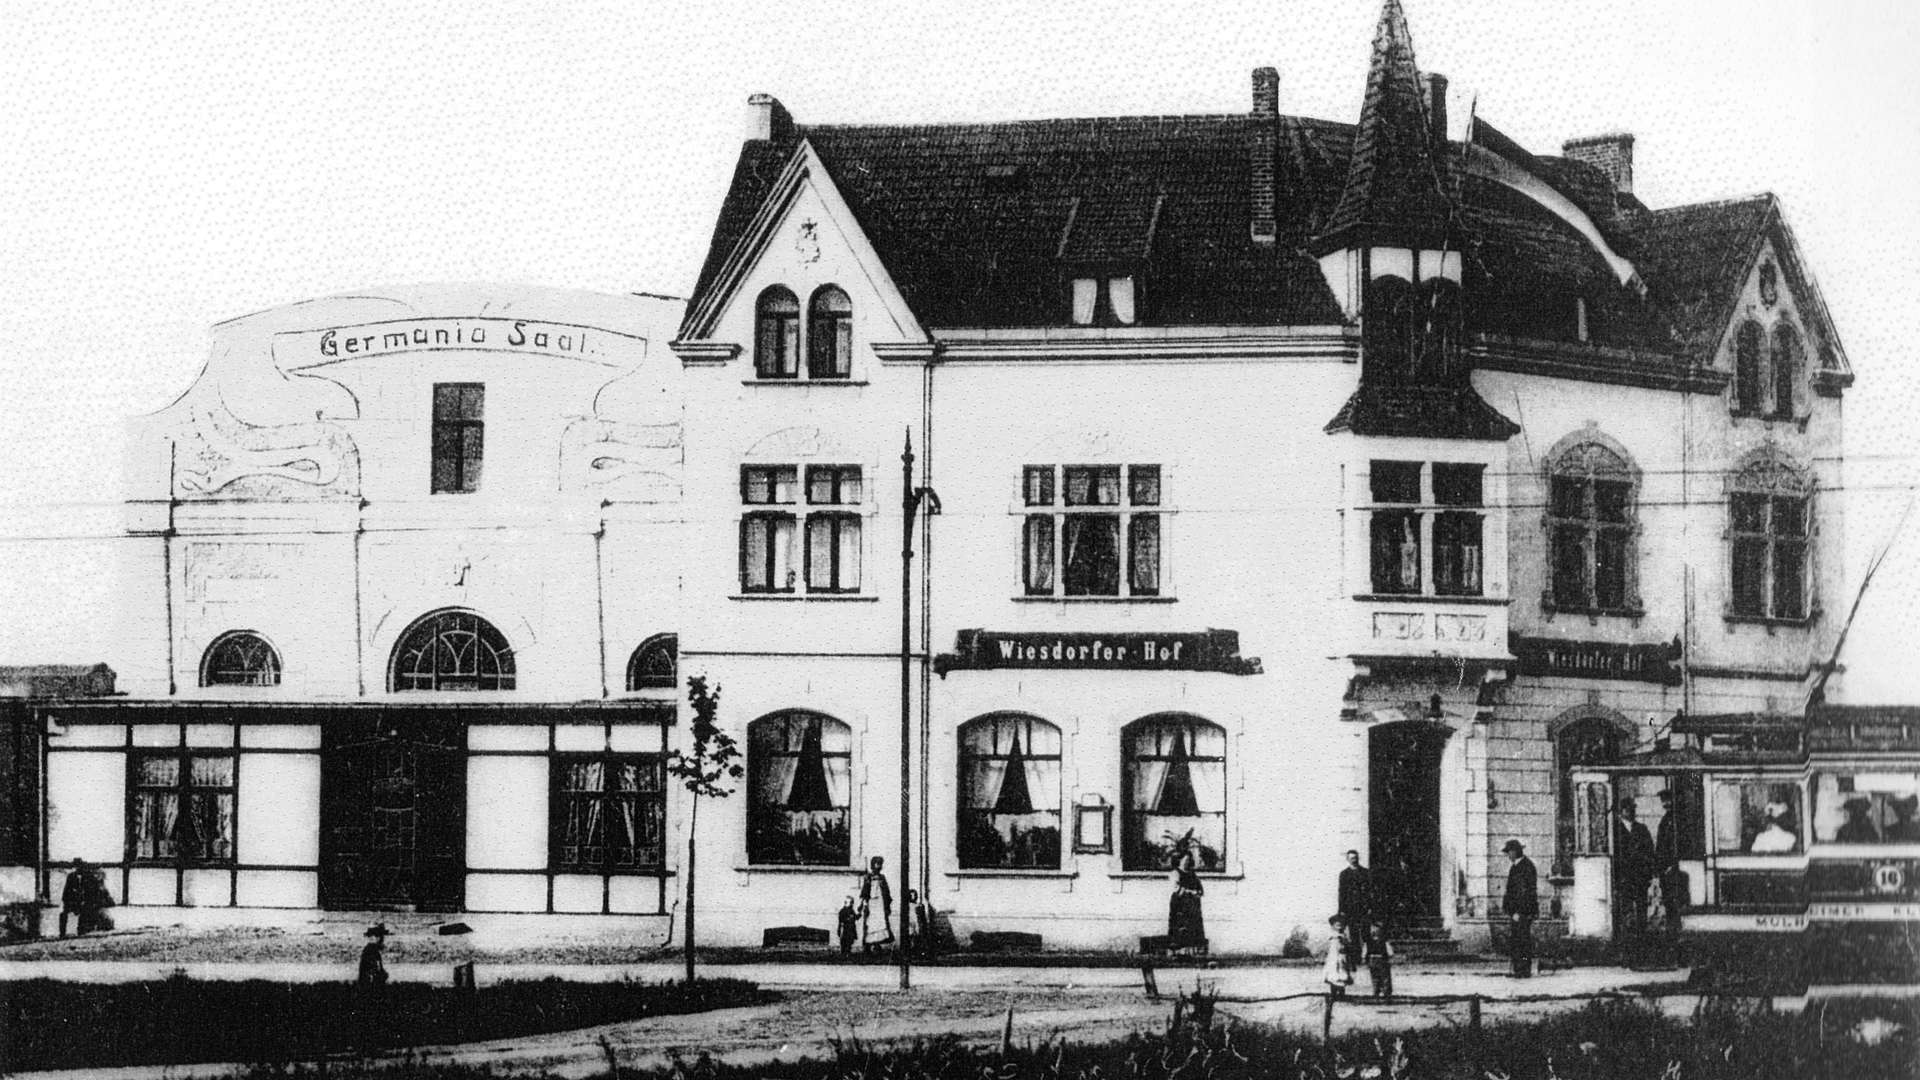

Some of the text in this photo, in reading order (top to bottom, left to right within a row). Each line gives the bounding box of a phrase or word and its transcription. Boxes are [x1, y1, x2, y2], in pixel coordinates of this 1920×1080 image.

[320, 322, 486, 356] Germania
[999, 640, 1183, 661] Wiesdorfer Hof
